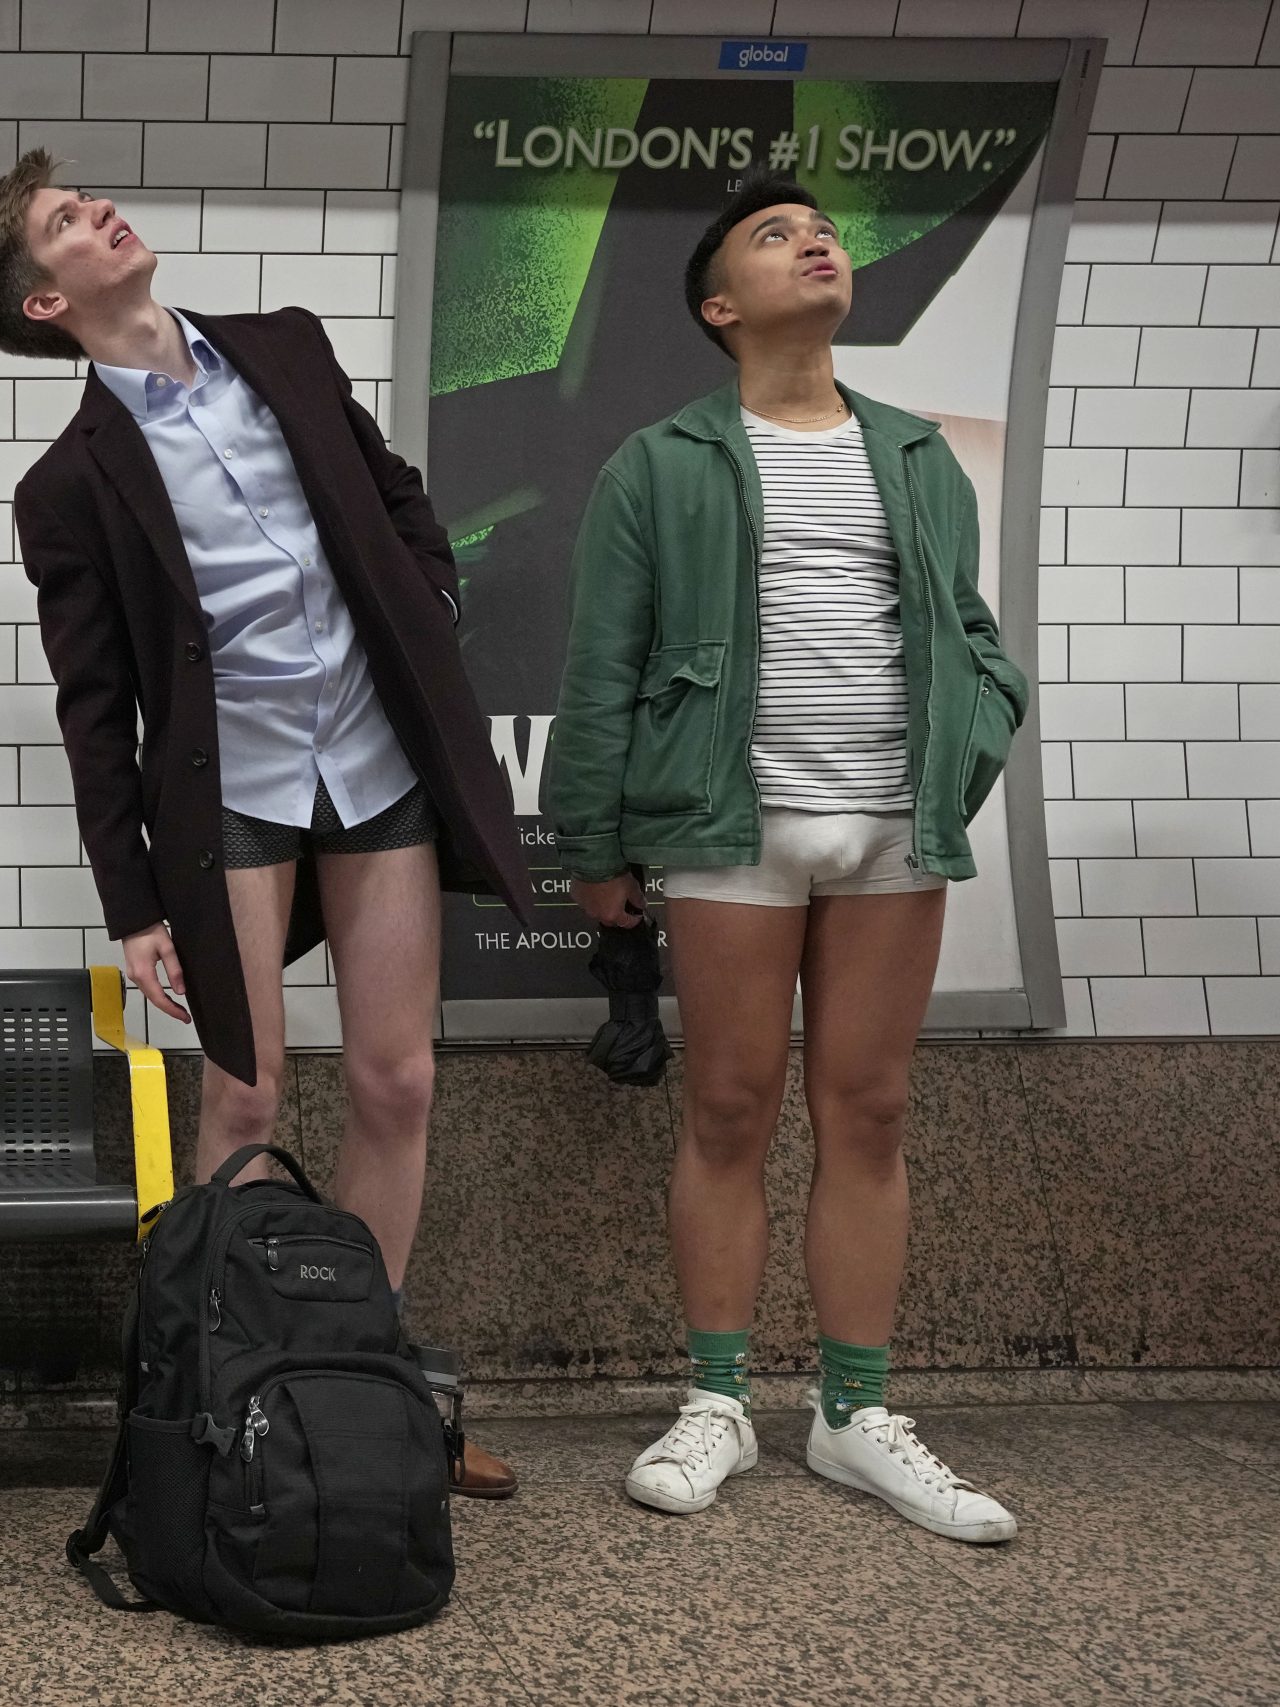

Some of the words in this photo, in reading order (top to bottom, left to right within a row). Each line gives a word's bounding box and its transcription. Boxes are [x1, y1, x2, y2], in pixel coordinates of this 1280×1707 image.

[738, 45, 789, 68] global
[473, 119, 755, 170] “LONDON’S
[768, 125, 819, 171] #1
[835, 124, 1017, 172] SHOW.”
[517, 824, 556, 845] icke
[474, 932, 511, 950] THE
[516, 931, 592, 949] APOLLO
[300, 1264, 337, 1281] ROCK
